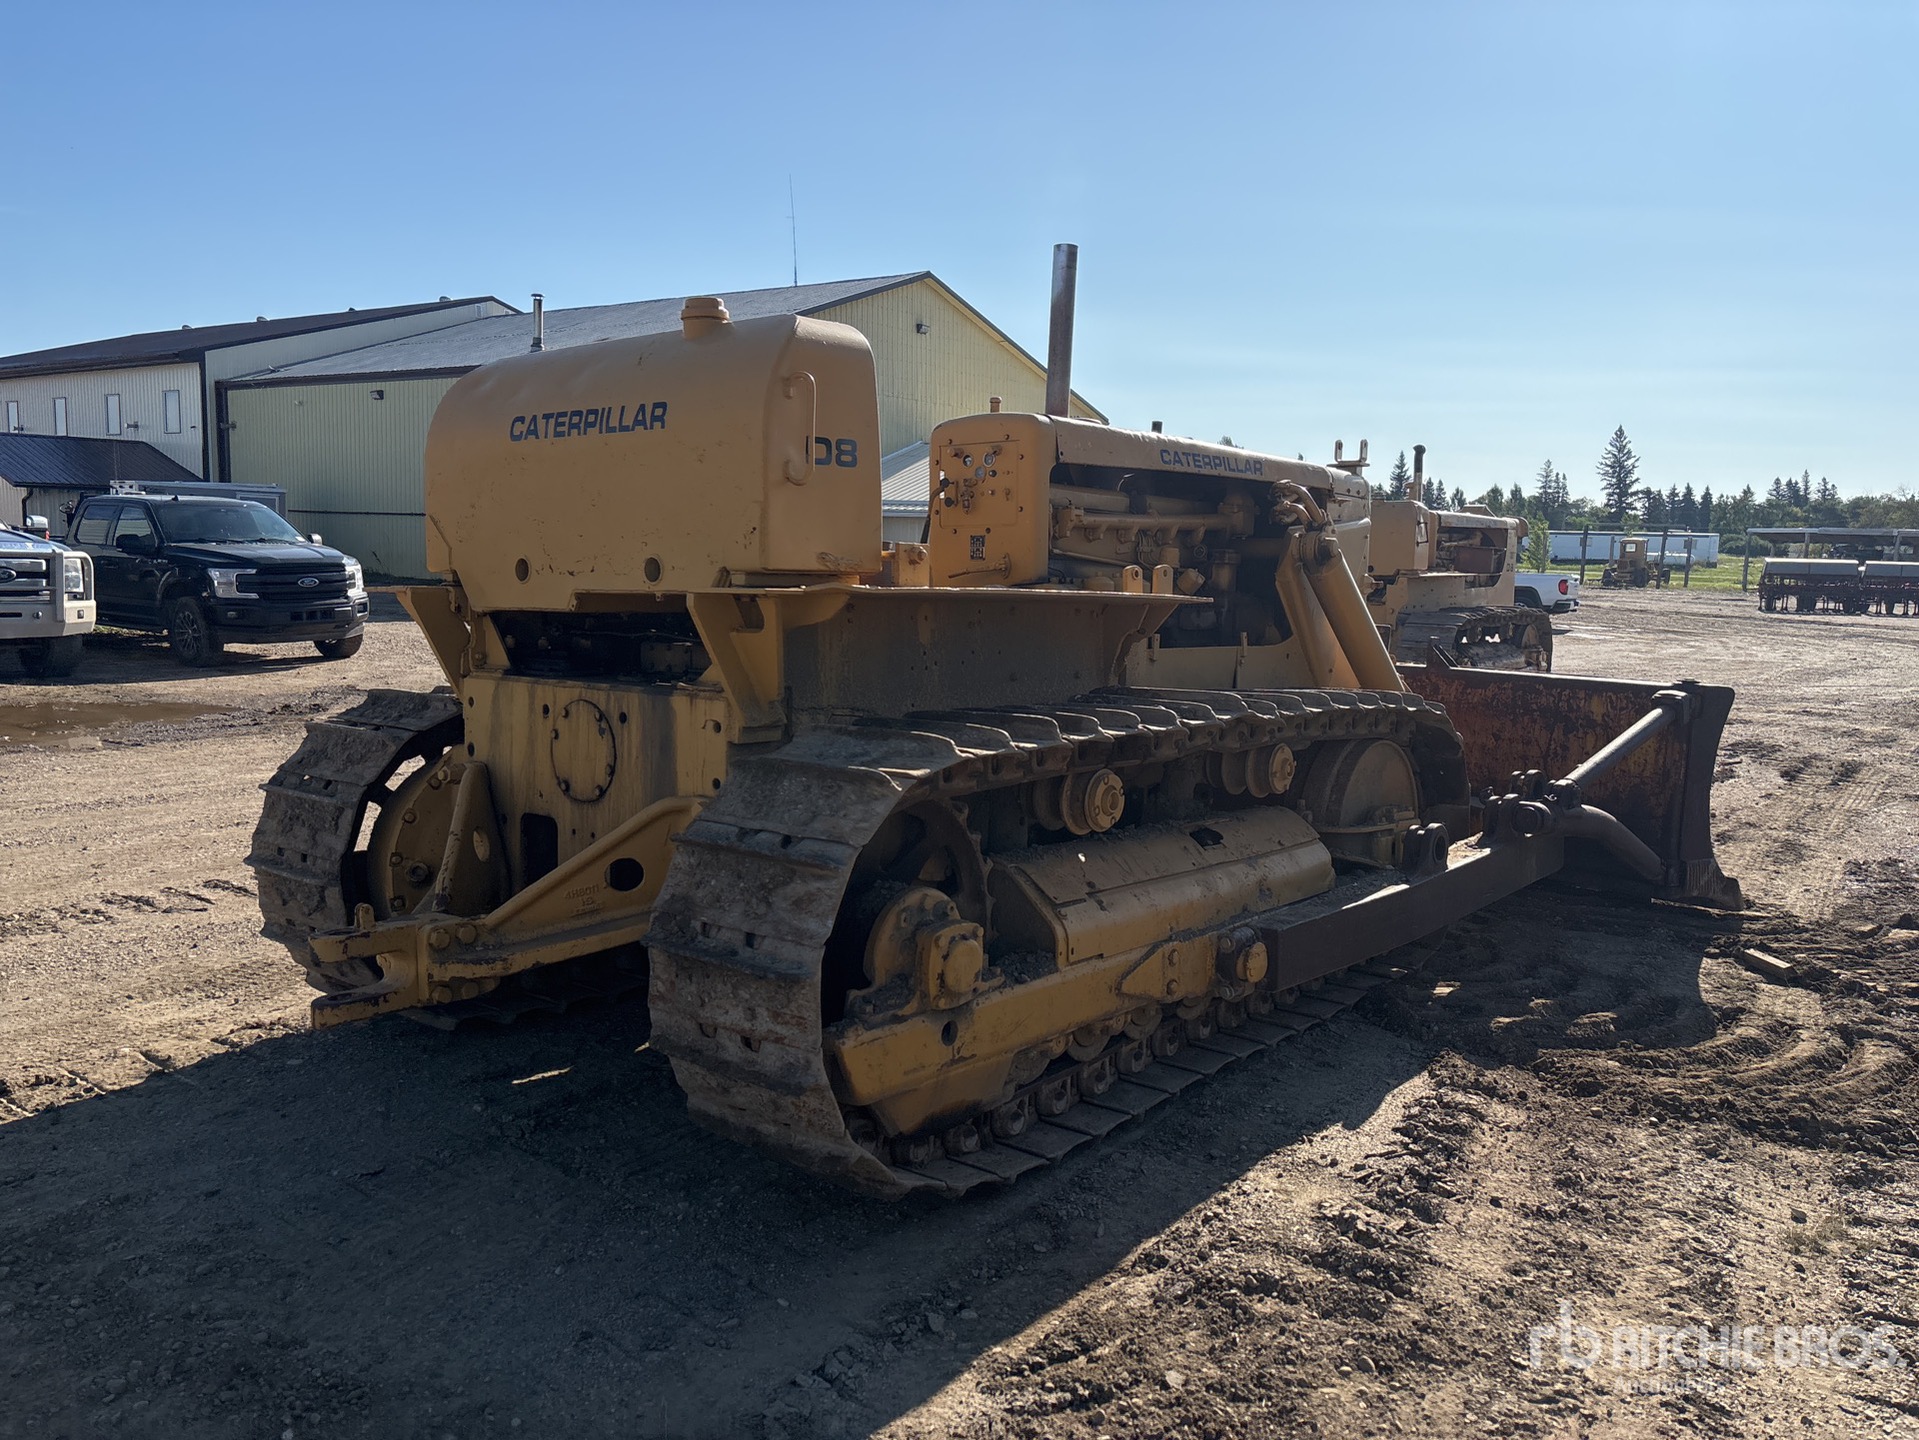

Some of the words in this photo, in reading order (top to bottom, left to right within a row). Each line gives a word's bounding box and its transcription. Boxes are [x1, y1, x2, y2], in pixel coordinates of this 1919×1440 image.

[509, 401, 668, 442] CATERPILLAR
[806, 435, 858, 468] D8
[1160, 449, 1263, 476] CATERPILLAR
